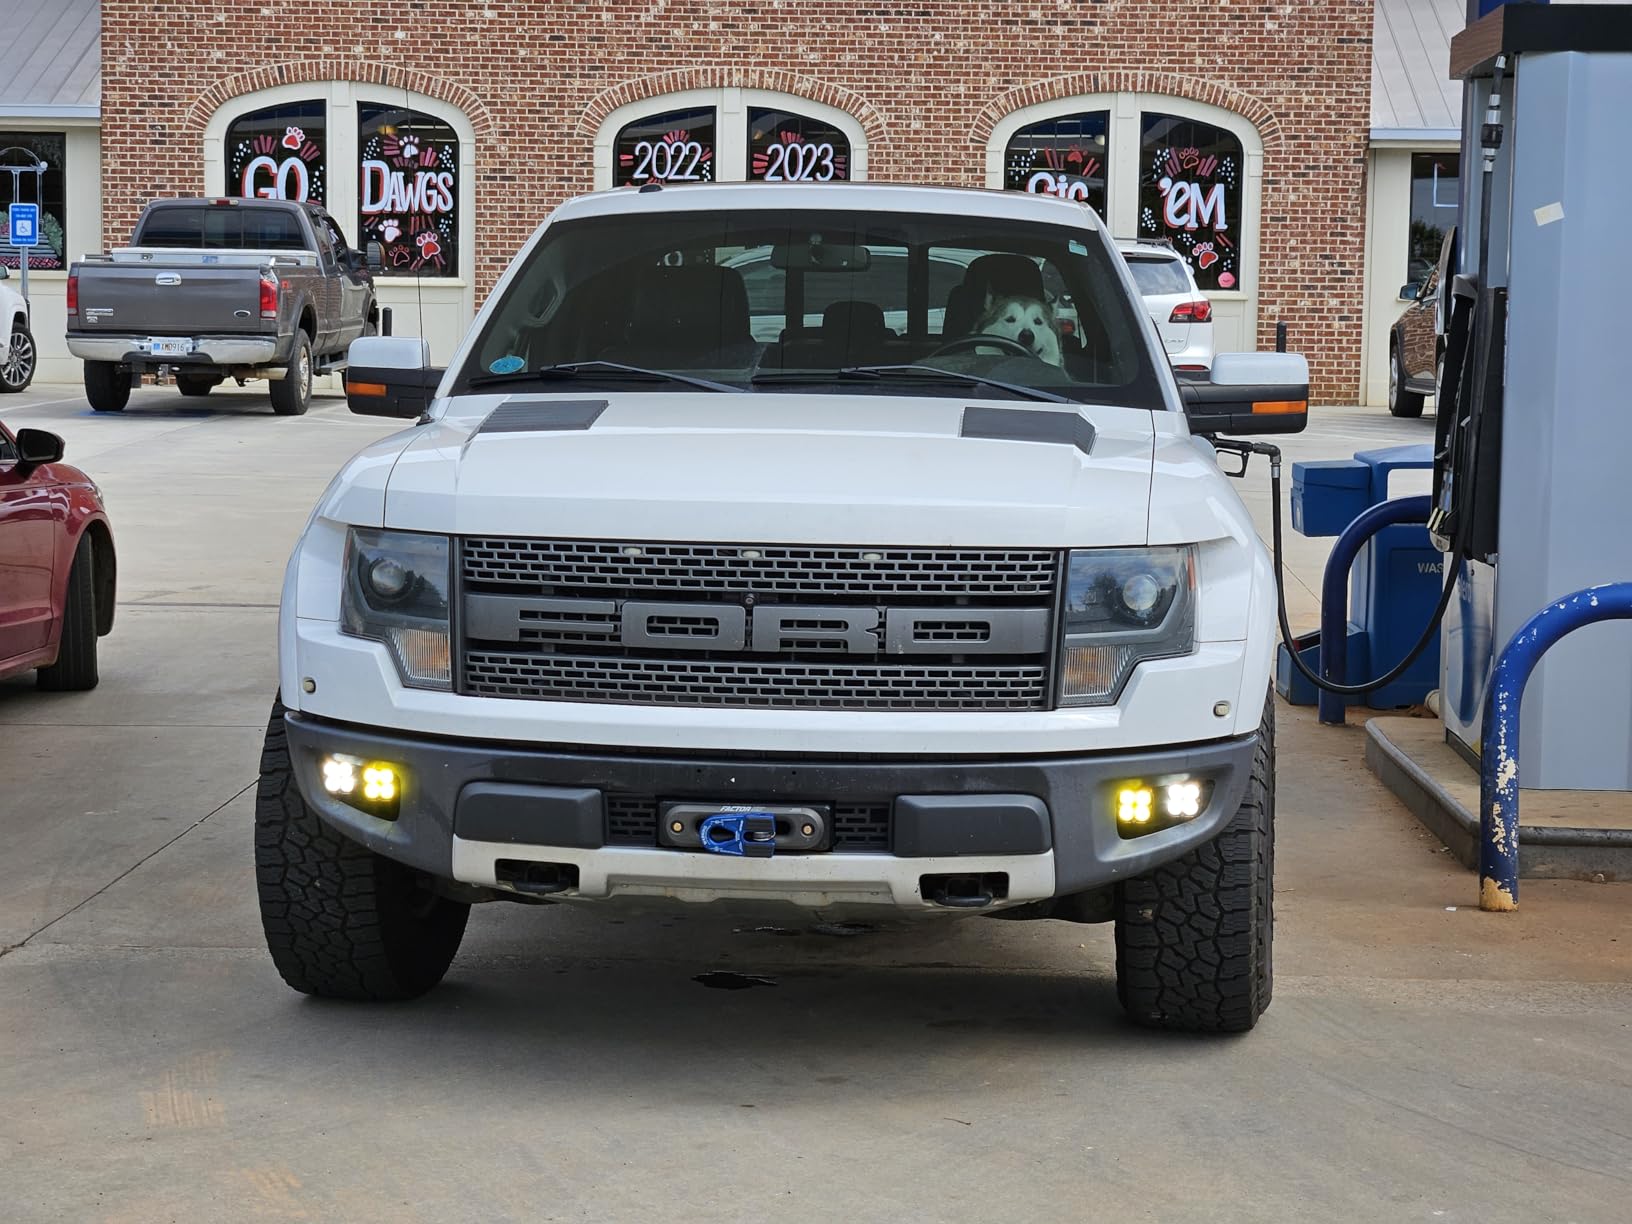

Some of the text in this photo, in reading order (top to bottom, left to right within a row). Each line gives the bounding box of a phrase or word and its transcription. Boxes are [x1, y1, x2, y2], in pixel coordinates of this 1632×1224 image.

[242, 156, 454, 213] GO DAWGS
[633, 142, 835, 181] 2022 2023
[465, 594, 1050, 655] FORD
